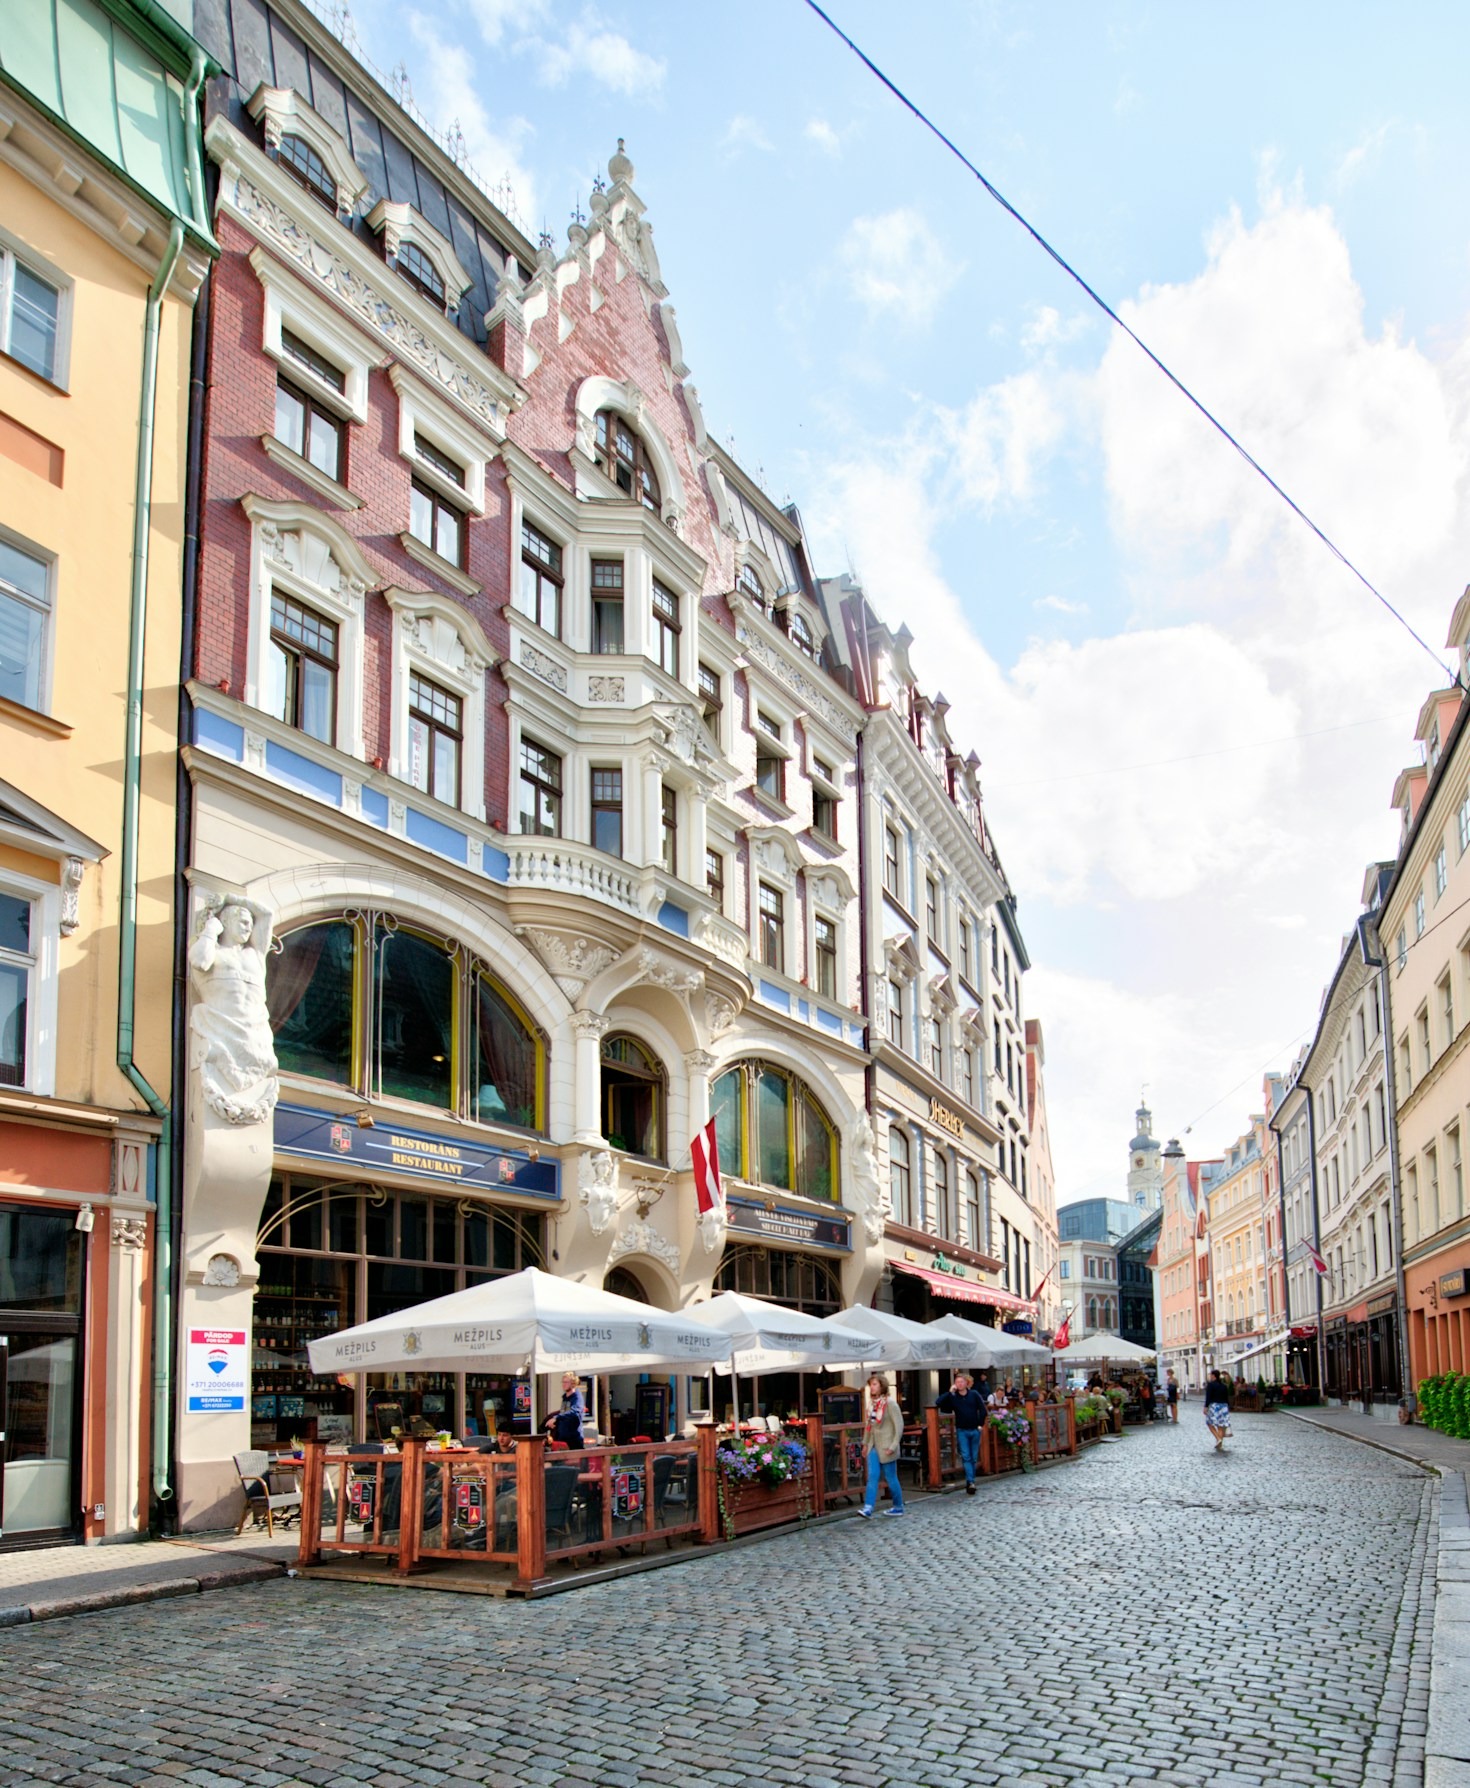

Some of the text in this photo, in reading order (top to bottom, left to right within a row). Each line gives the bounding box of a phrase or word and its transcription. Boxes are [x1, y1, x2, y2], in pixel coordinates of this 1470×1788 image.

[391, 1135, 460, 1158] RESTORĀNS
[392, 1152, 463, 1175] RESTAURANT
[204, 1331, 234, 1339] PĀRDOD
[454, 1327, 503, 1343] MEŽPILS
[570, 1326, 612, 1340] MEŽPILS
[677, 1333, 711, 1347] MEŽPILS
[336, 1341, 376, 1357] MEŽPILS
